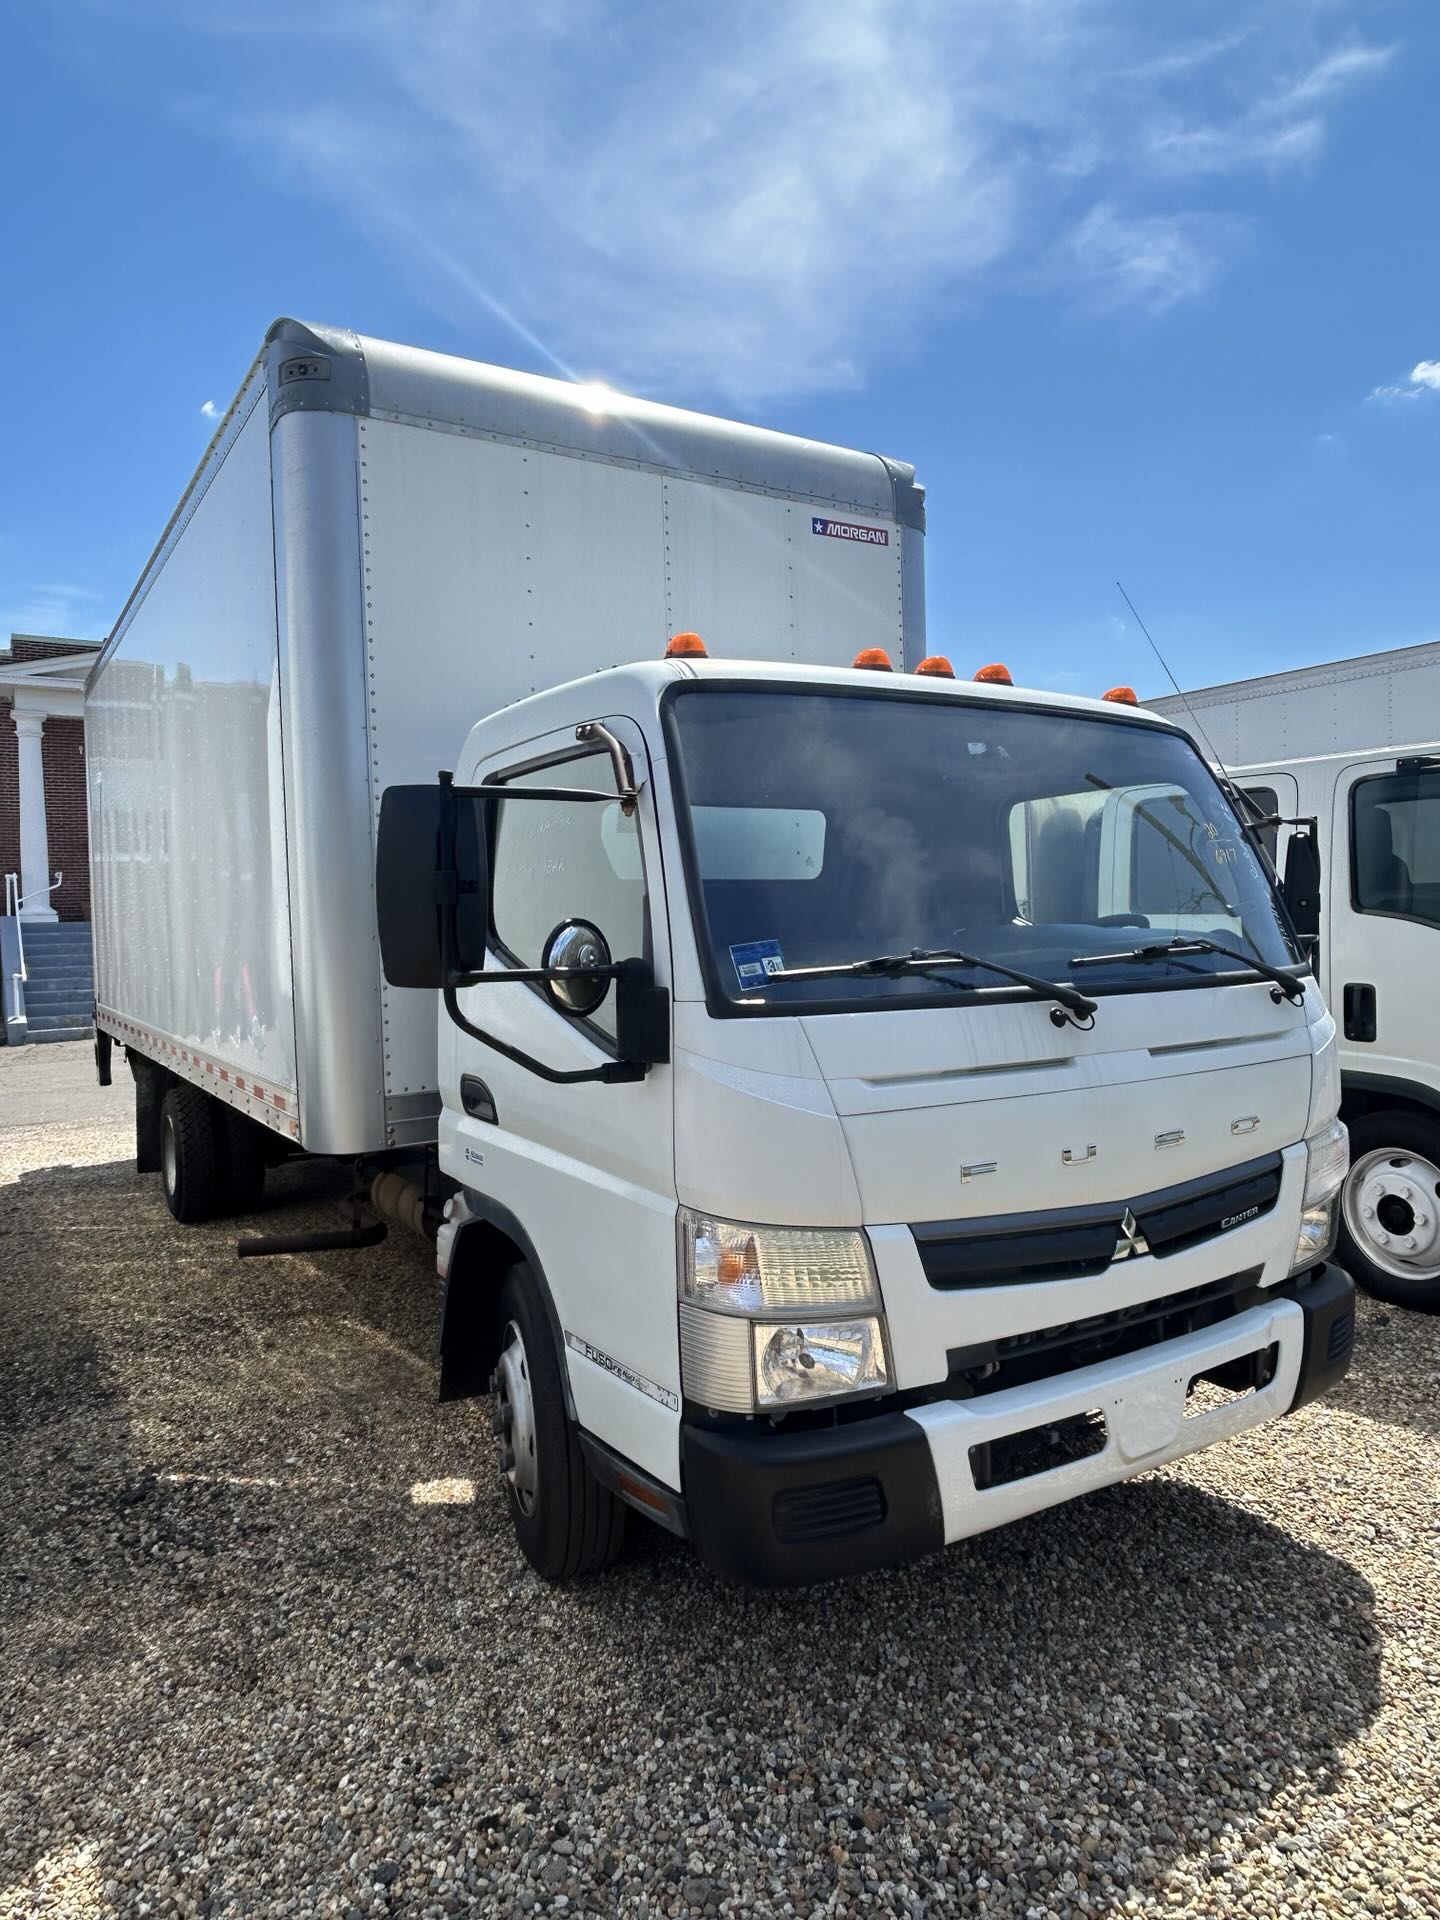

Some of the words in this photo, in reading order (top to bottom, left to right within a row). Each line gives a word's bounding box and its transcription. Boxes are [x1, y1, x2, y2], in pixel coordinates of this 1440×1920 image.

[826, 523, 887, 544] MORGAN
[960, 1116, 1261, 1185] FUSO
[585, 1344, 613, 1371] FUSO
